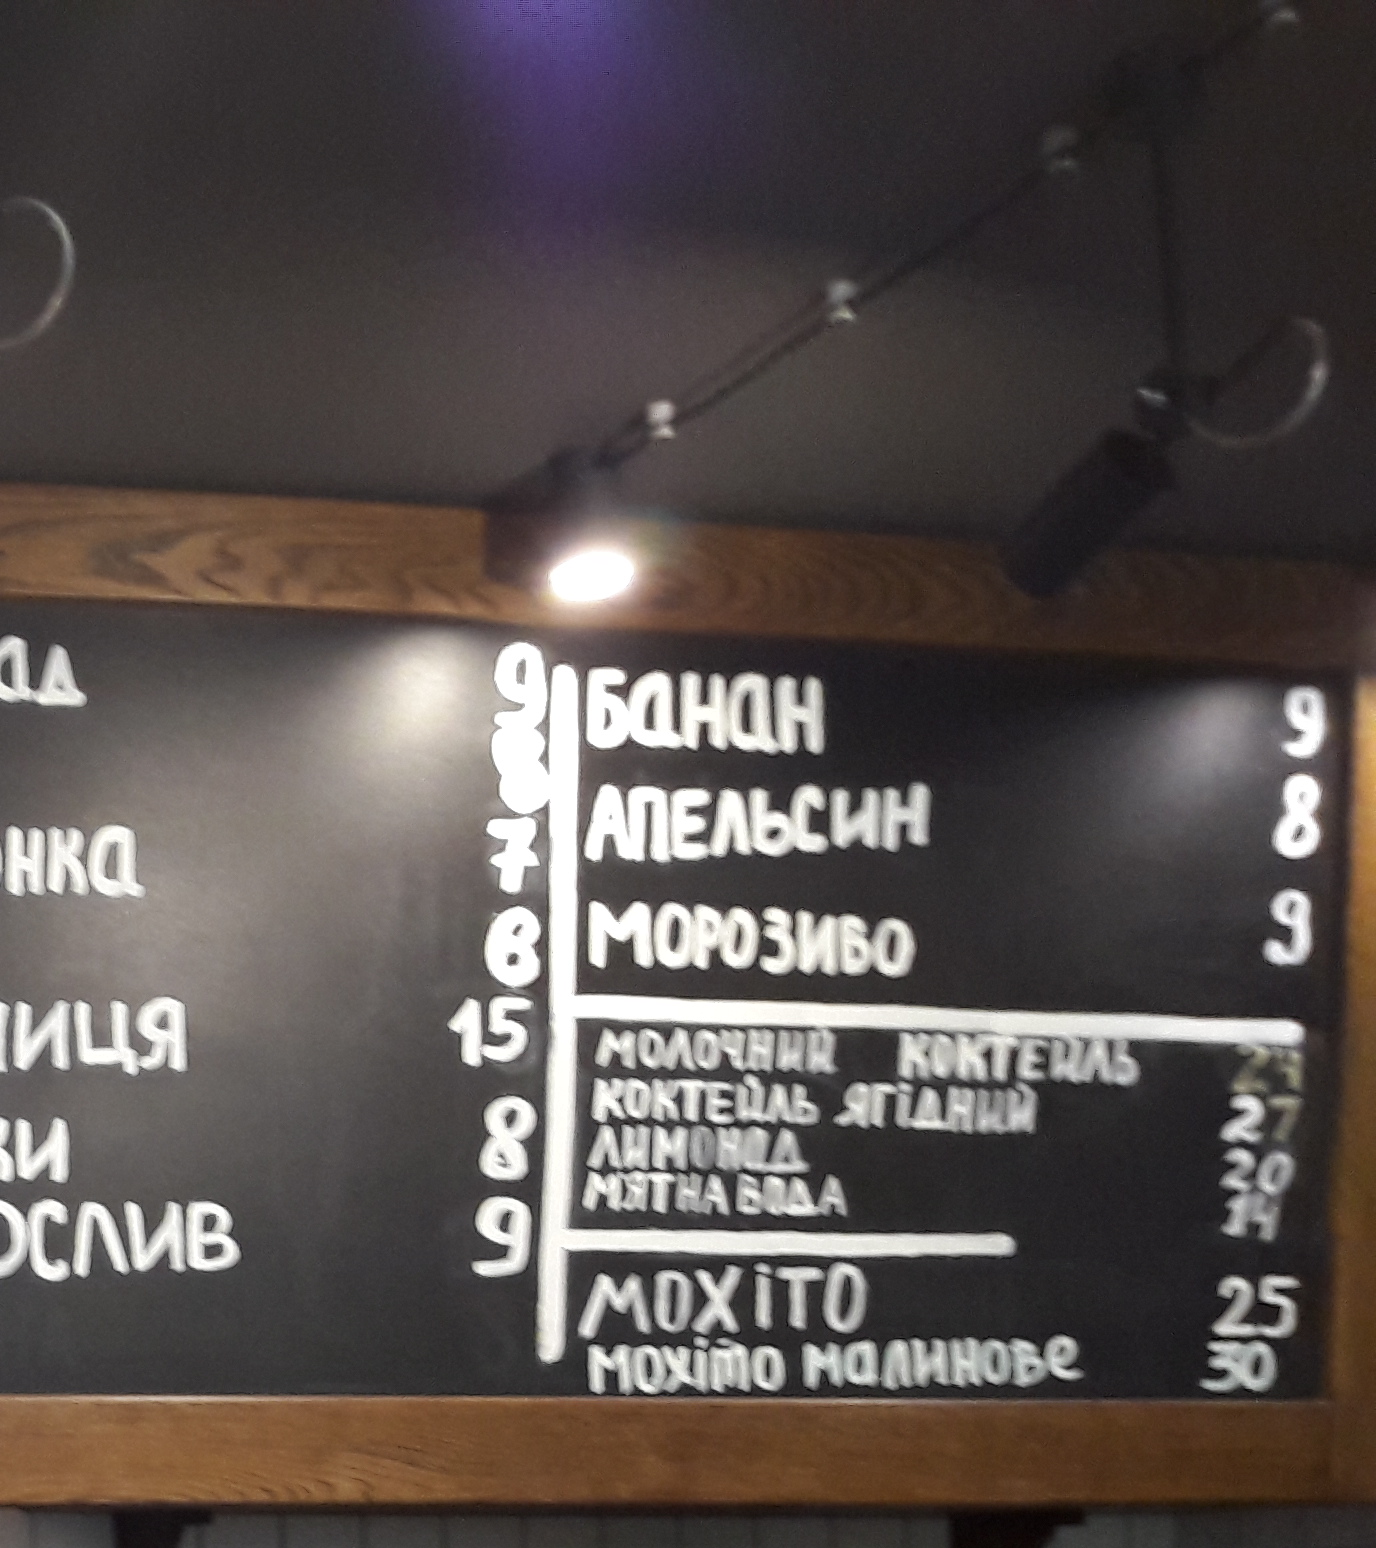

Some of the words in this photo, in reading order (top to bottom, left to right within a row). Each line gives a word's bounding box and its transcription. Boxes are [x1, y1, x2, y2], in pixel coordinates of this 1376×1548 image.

[494, 641, 548, 724] 9
[585, 667, 827, 756] БАНАН
[1283, 686, 1328, 761] 9
[486, 815, 541, 895] 7
[583, 782, 932, 864] АПЕЛЬСИН
[1272, 773, 1324, 859] 8
[1264, 888, 1313, 967] 9
[447, 995, 532, 1069] 15
[479, 1096, 539, 1184] 8
[1218, 1092, 1304, 1143] 27
[1218, 1147, 1297, 1197] 20
[471, 1195, 533, 1278] 9
[1211, 1274, 1302, 1339] 25
[1199, 1339, 1278, 1393] 30
